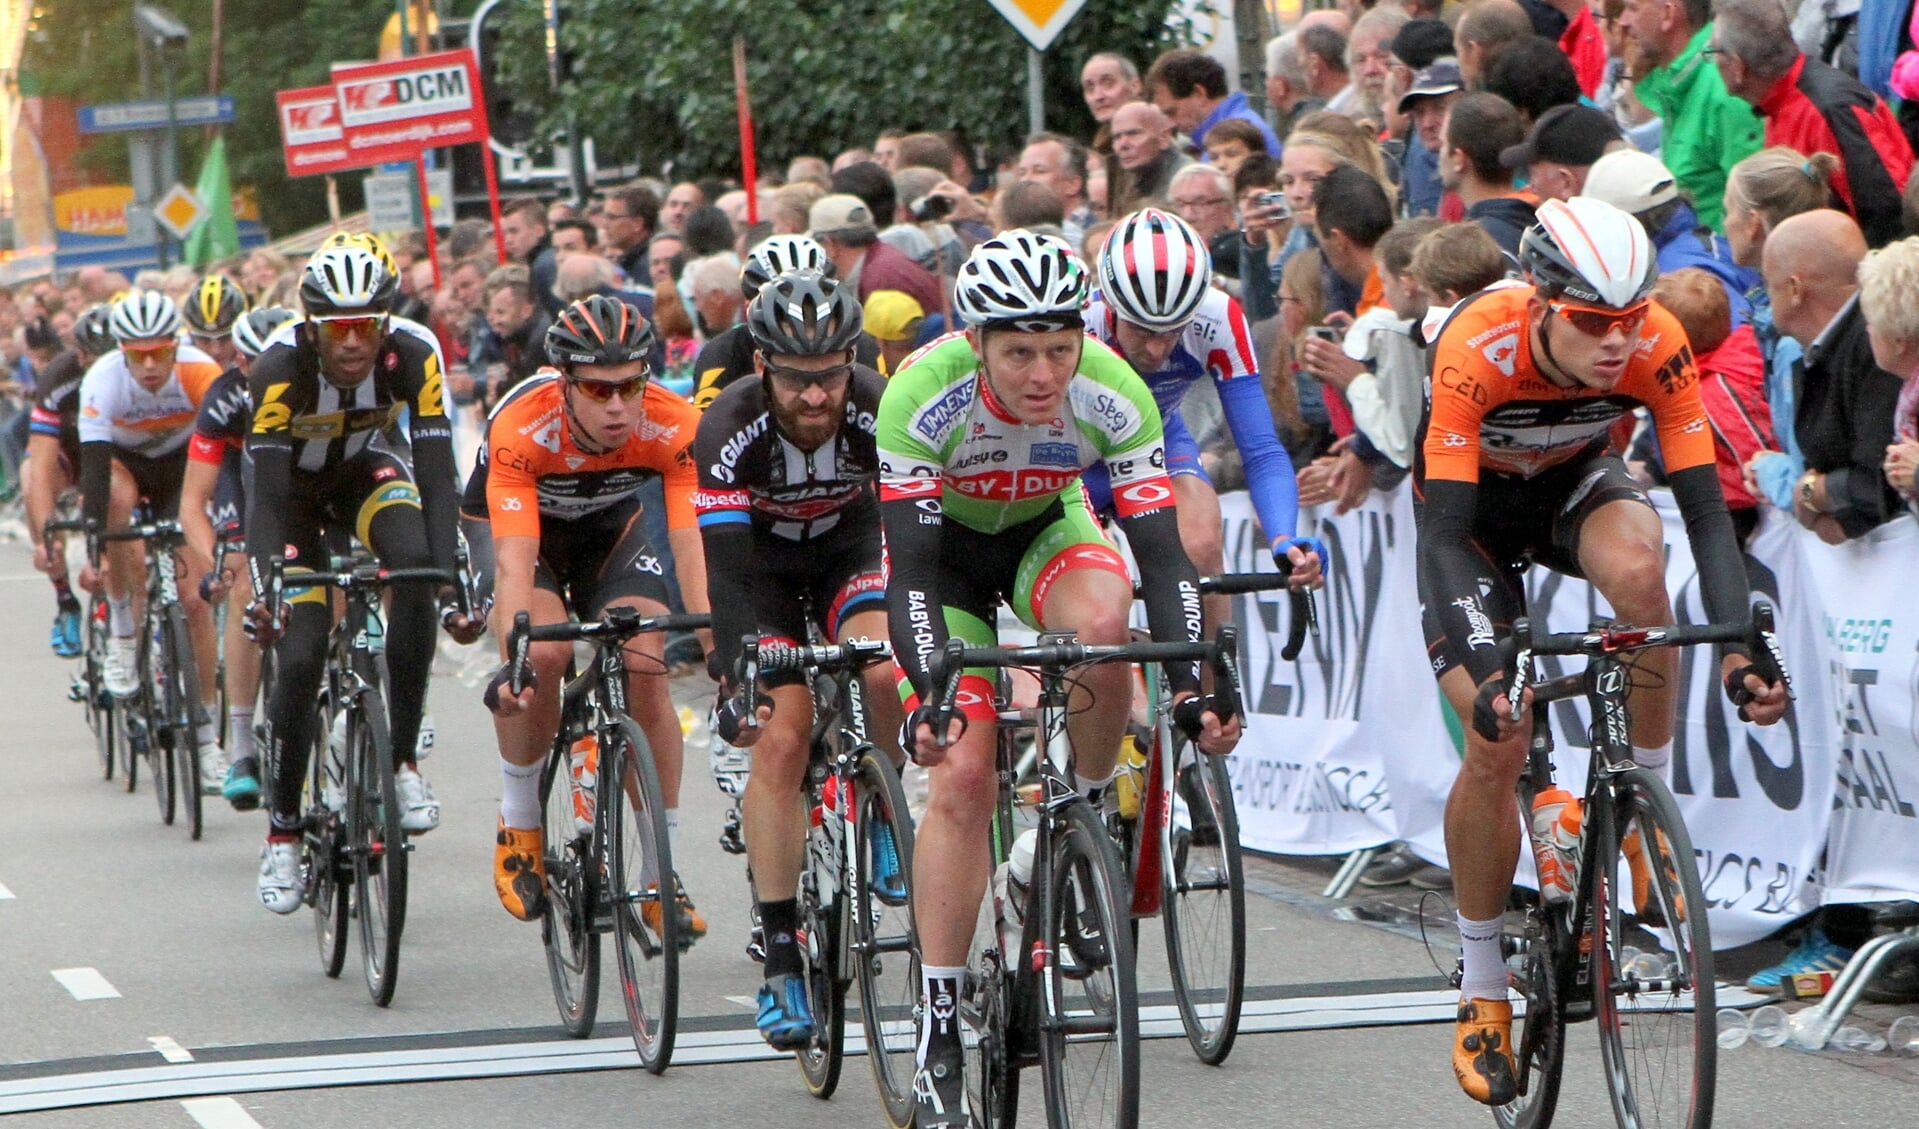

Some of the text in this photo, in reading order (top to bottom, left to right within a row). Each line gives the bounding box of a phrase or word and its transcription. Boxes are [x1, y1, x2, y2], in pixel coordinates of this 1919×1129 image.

[396, 69, 464, 103] DCM
[720, 410, 771, 470] GIANT
[501, 497, 522, 511] 36
[689, 490, 750, 508] Alpecin
[1451, 595, 1497, 651] Roompot
[849, 679, 867, 740] GIANT
[1604, 700, 1620, 747] ISAAC
[849, 866, 859, 924] GIANT
